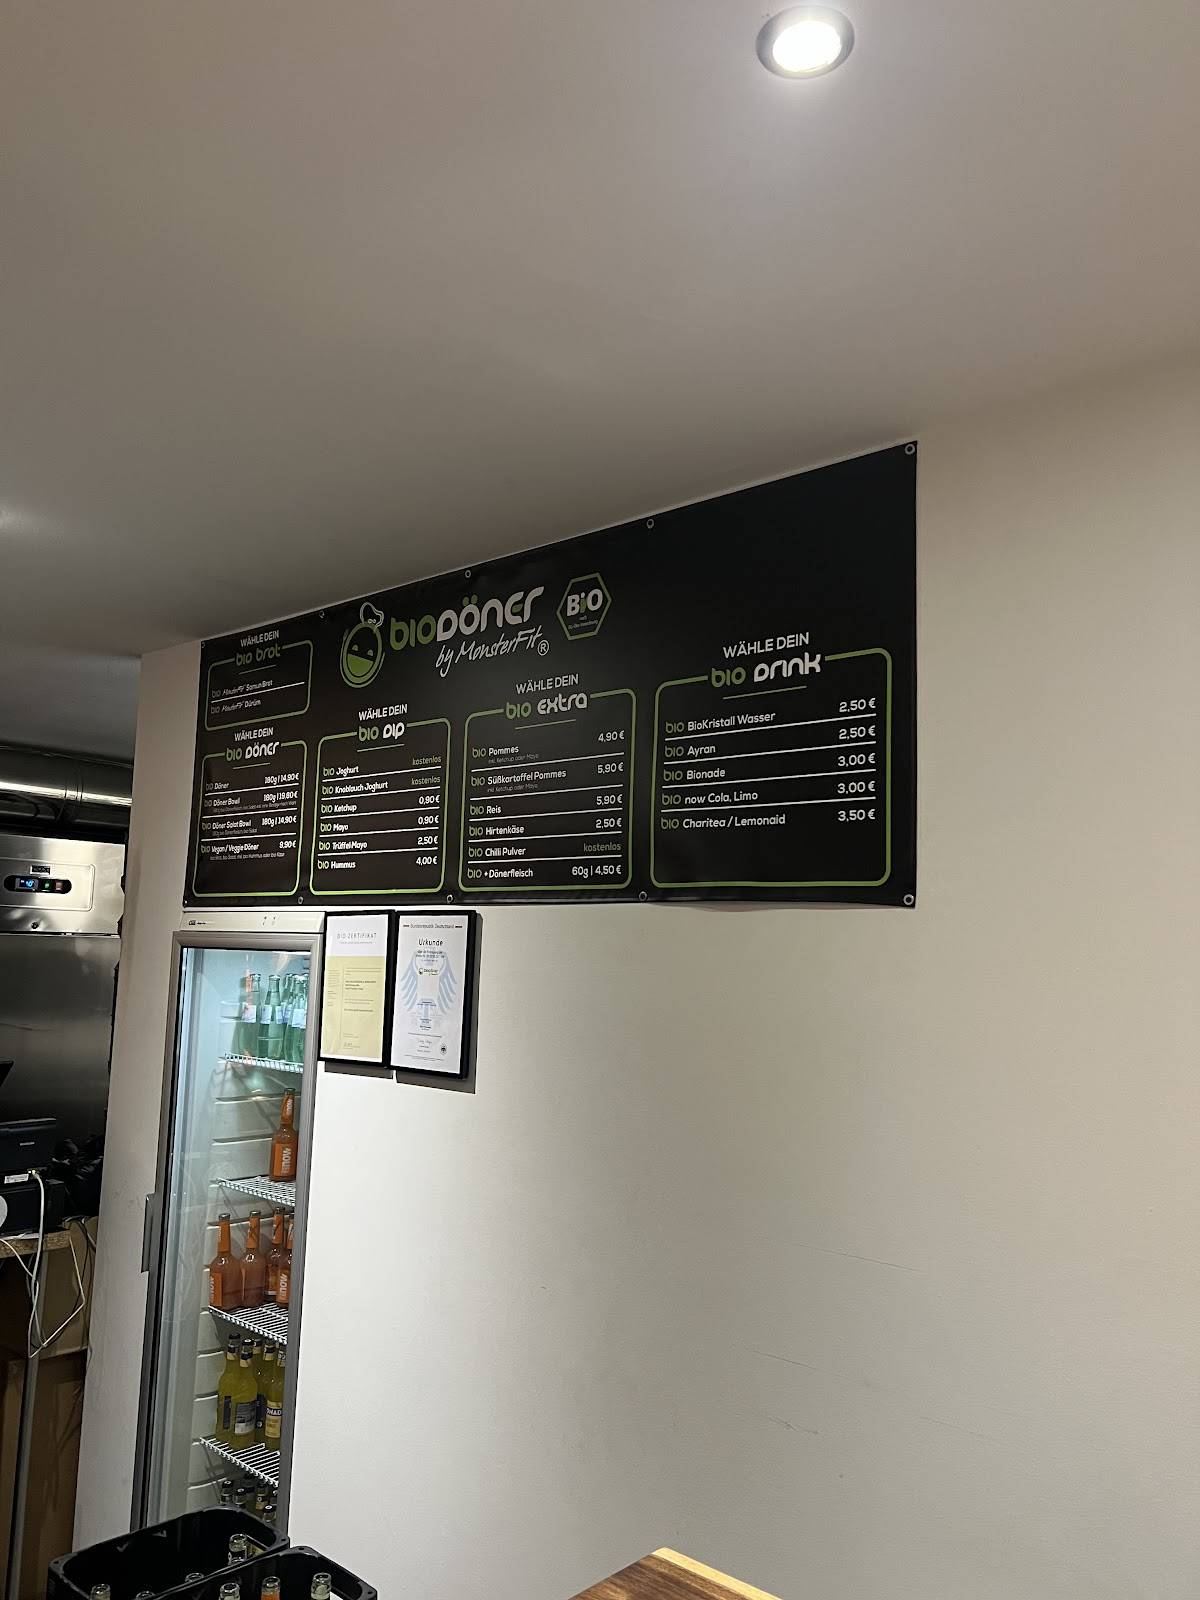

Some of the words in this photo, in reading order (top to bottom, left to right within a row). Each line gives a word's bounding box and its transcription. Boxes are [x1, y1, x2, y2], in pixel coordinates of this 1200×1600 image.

[240, 634, 263, 648] WÄHLE
[264, 630, 279, 640] DEIN
[723, 639, 773, 658] WÄHLE
[777, 632, 809, 650] DEIN
[236, 652, 252, 666] bio
[256, 643, 280, 661] brot
[436, 646, 453, 677] by
[516, 678, 553, 694] WÄHLE
[555, 674, 579, 687] DEIN
[711, 667, 746, 687] bio
[359, 709, 388, 720] WÄHLE
[389, 704, 407, 716] DEIN
[506, 702, 531, 719] bio
[665, 722, 684, 733] bio
[687, 716, 735, 731] BioKristall
[737, 713, 775, 724] Wasser
[234, 729, 257, 742] WÄHLE
[258, 727, 274, 738] DEIN
[359, 726, 379, 741] bio
[226, 748, 242, 761] bio
[472, 748, 486, 758] bio
[489, 747, 519, 756] Pommes
[665, 745, 684, 757] bio
[687, 744, 716, 756] Ayran
[323, 768, 334, 776] bio
[336, 766, 359, 776] Joghurt
[413, 756, 441, 765] kostenlos
[471, 776, 485, 786] bio
[488, 772, 533, 784] Süßkartoffel
[534, 770, 566, 779] Pommes
[663, 769, 683, 781] bio
[686, 769, 725, 780] Bionade
[322, 786, 333, 794] bio
[411, 776, 440, 785] kostenlos
[662, 793, 681, 805] bio
[685, 796, 705, 805] now
[734, 791, 758, 801] Limo
[334, 804, 357, 813] Ketchup
[470, 805, 484, 815] bio
[487, 805, 501, 813] Reis
[321, 823, 332, 831] bio
[333, 823, 348, 832] Mayo
[661, 818, 679, 829] bio
[683, 817, 726, 828] Charitea
[735, 814, 785, 826] Lemonaid
[469, 826, 483, 836] bio
[486, 825, 524, 835] Hirtenkäse
[319, 842, 330, 850] bio
[469, 847, 482, 857] bio
[502, 847, 526, 855] Pulver
[584, 842, 621, 851] kostenlos
[318, 860, 329, 869] bio
[468, 868, 481, 878] bio
[572, 867, 588, 877] 60g
